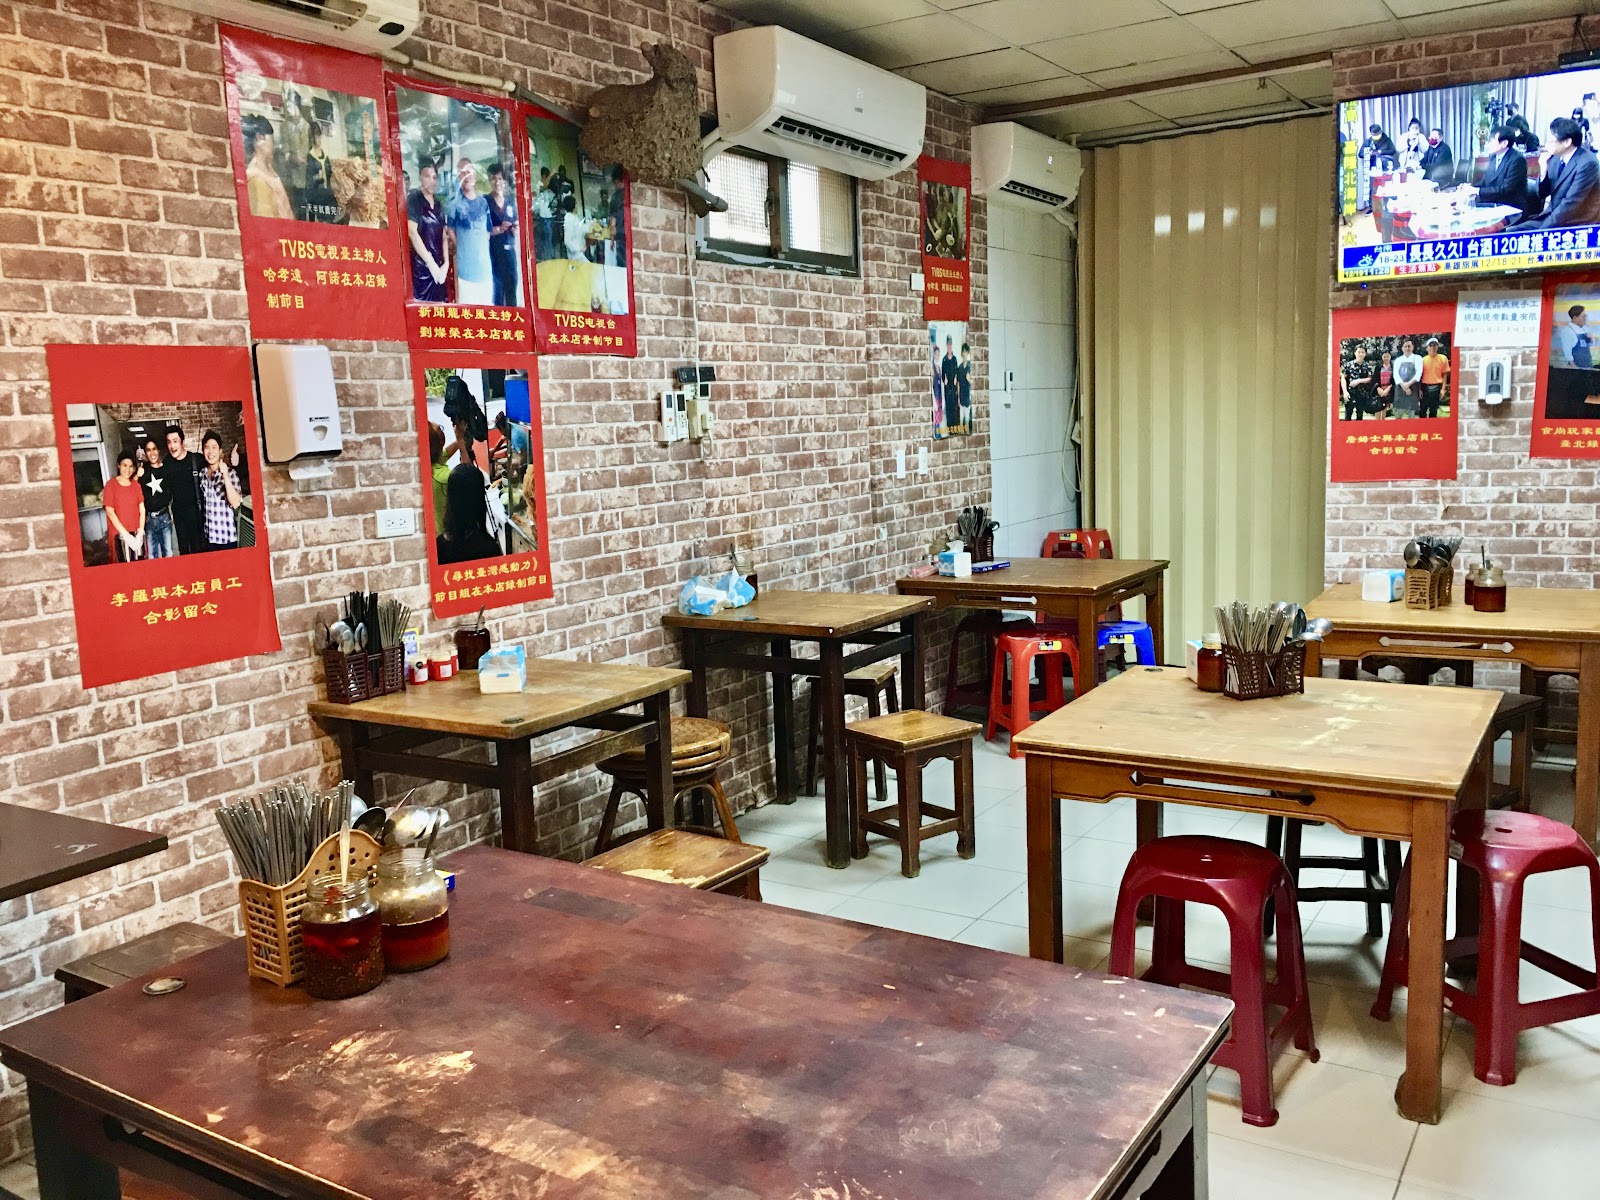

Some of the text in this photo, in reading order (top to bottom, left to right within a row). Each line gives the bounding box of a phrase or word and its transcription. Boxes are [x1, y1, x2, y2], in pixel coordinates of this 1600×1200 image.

[278, 239, 387, 265] TVBS電視臺主持人
[1374, 244, 1392, 253] 台南
[1379, 254, 1405, 264] 18-23
[266, 293, 305, 309] 制節目
[418, 305, 525, 323] 新聞龍卷風主持人
[554, 313, 617, 330] TVBS电视台
[419, 325, 526, 342] 劉燦榮在本店就餐
[547, 333, 624, 347] 在本店录制节目
[1345, 433, 1443, 444] 詹姆士與本店員工
[1369, 445, 1418, 455] 合影留念
[110, 576, 243, 607] 李羅與本店員工
[142, 601, 218, 625] 合影留念
